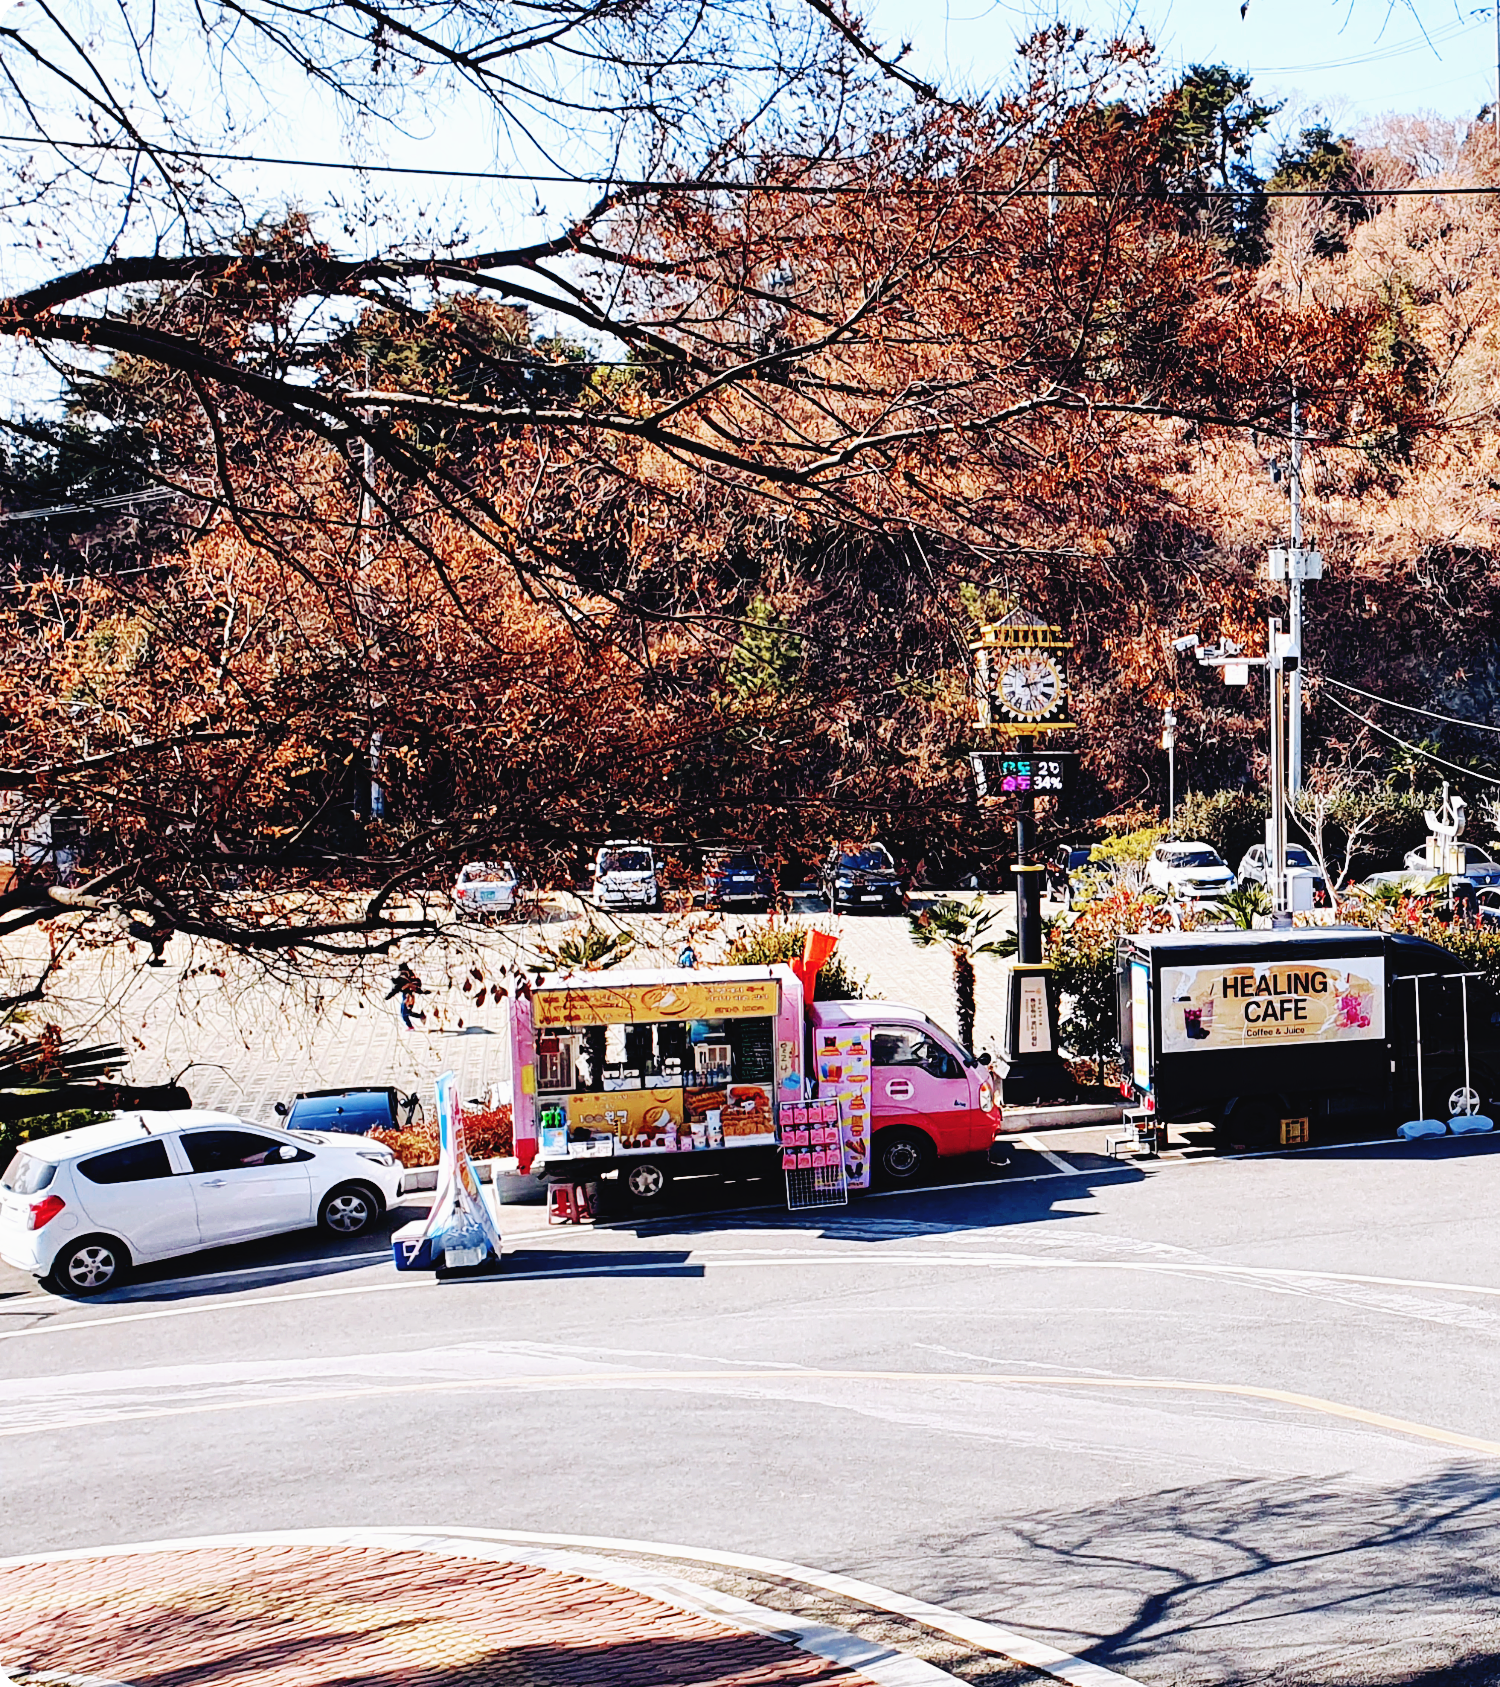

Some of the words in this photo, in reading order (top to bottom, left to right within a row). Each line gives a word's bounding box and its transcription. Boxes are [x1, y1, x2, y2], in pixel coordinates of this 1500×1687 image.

[1033, 776, 1063, 790] 34%
[1222, 971, 1328, 999] HEALING
[1244, 998, 1308, 1023] CAFE
[1246, 1028, 1273, 1038] Coffee
[1284, 1025, 1305, 1035] Juice
